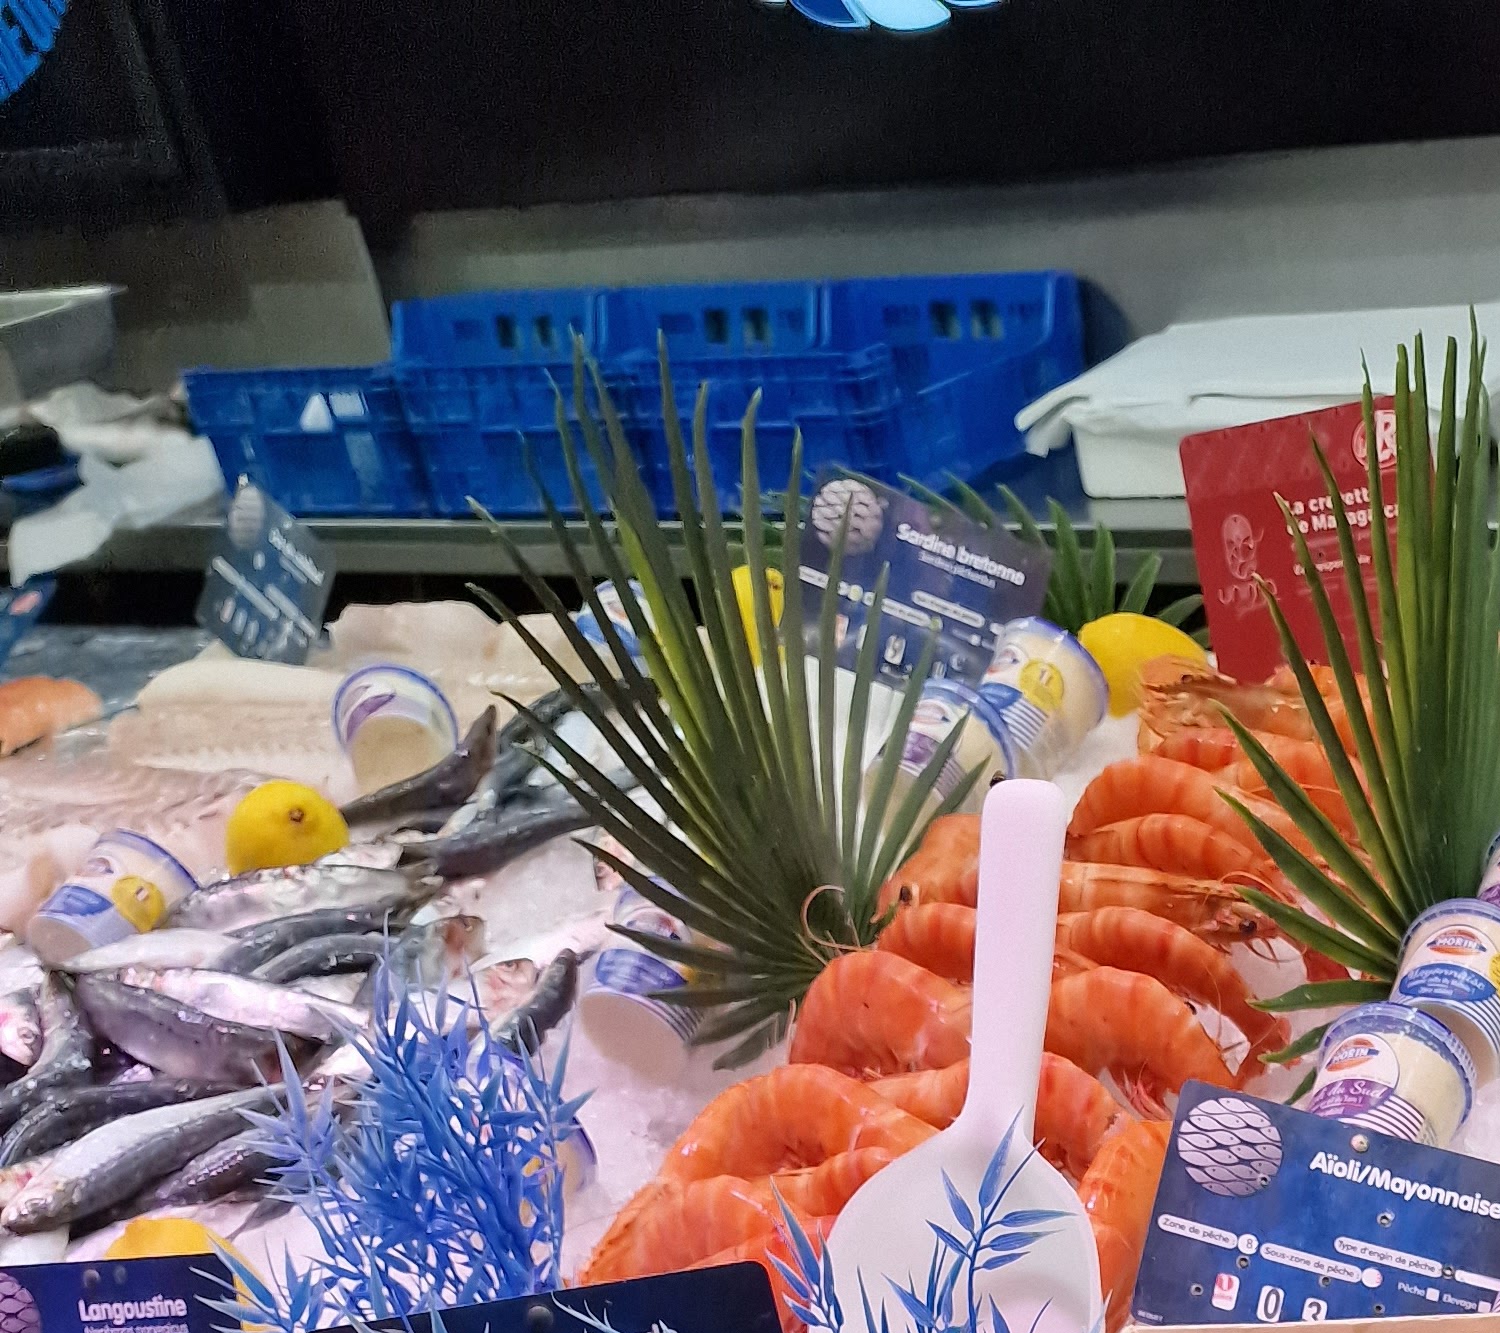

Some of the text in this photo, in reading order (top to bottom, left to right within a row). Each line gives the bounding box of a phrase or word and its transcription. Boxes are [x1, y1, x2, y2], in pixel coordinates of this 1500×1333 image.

[1435, 935, 1479, 950] MORIN
[1331, 1046, 1371, 1065] MORIN
[1350, 1080, 1390, 1101] Sud
[1162, 1216, 1186, 1232] Zone
[1188, 1224, 1201, 1236] de
[1337, 1238, 1358, 1257] Type
[1395, 1253, 1408, 1266] de
[1311, 1258, 1325, 1273] de
[78, 1294, 187, 1324] Langoustine
